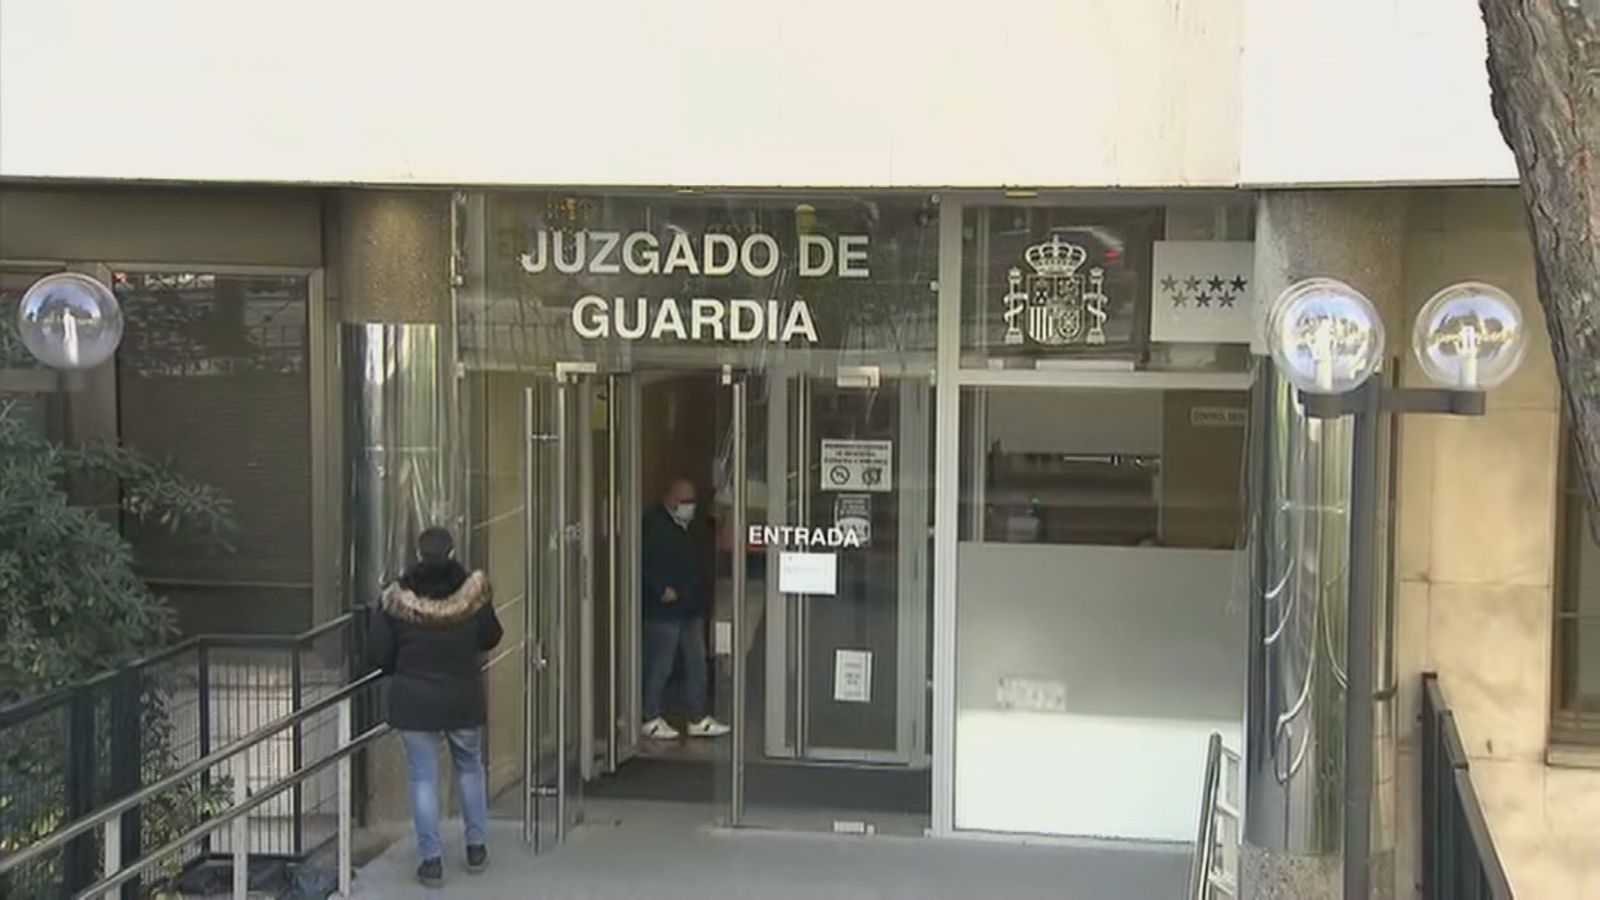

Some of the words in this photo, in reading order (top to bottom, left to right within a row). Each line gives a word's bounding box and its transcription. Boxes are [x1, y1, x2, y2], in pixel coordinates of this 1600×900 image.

[521, 231, 780, 276] JUZGADO
[799, 235, 870, 278] DE
[571, 295, 819, 343] GUARDIA
[748, 524, 860, 548] ENTRADA
